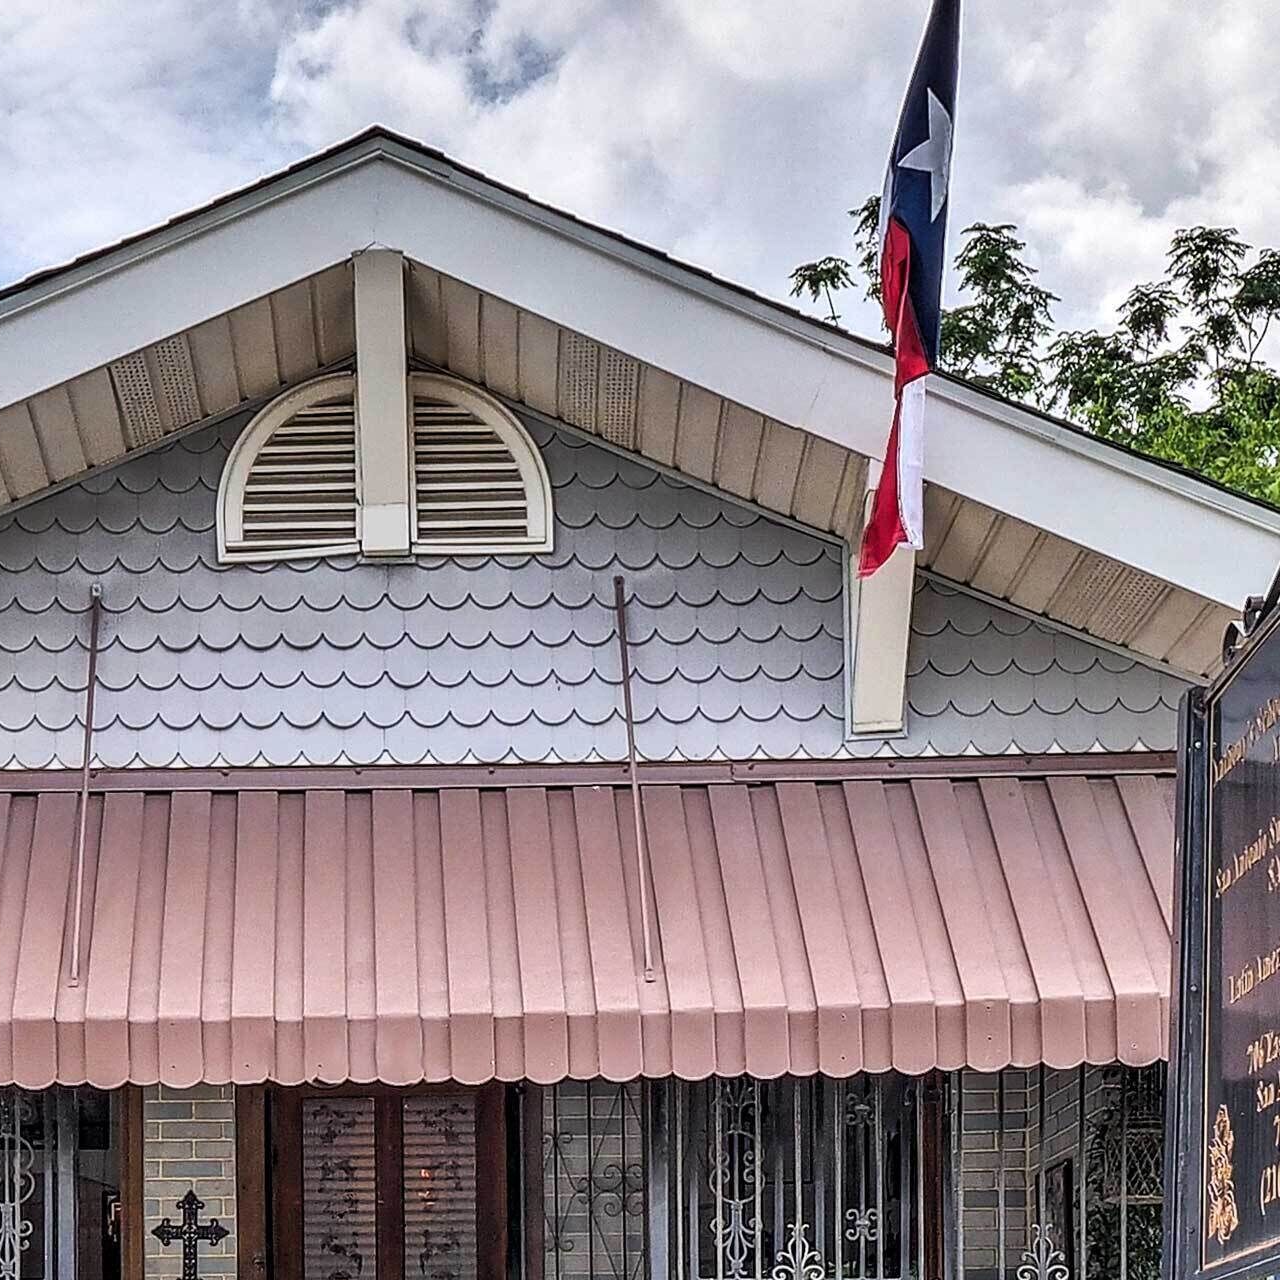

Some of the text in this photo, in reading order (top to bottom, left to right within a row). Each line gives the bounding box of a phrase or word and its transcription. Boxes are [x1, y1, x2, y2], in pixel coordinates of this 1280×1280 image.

[1215, 868, 1231, 899] San
[1232, 829, 1268, 885] Antonio
[1228, 963, 1254, 1005] Latin
[1256, 1080, 1275, 1113] San
